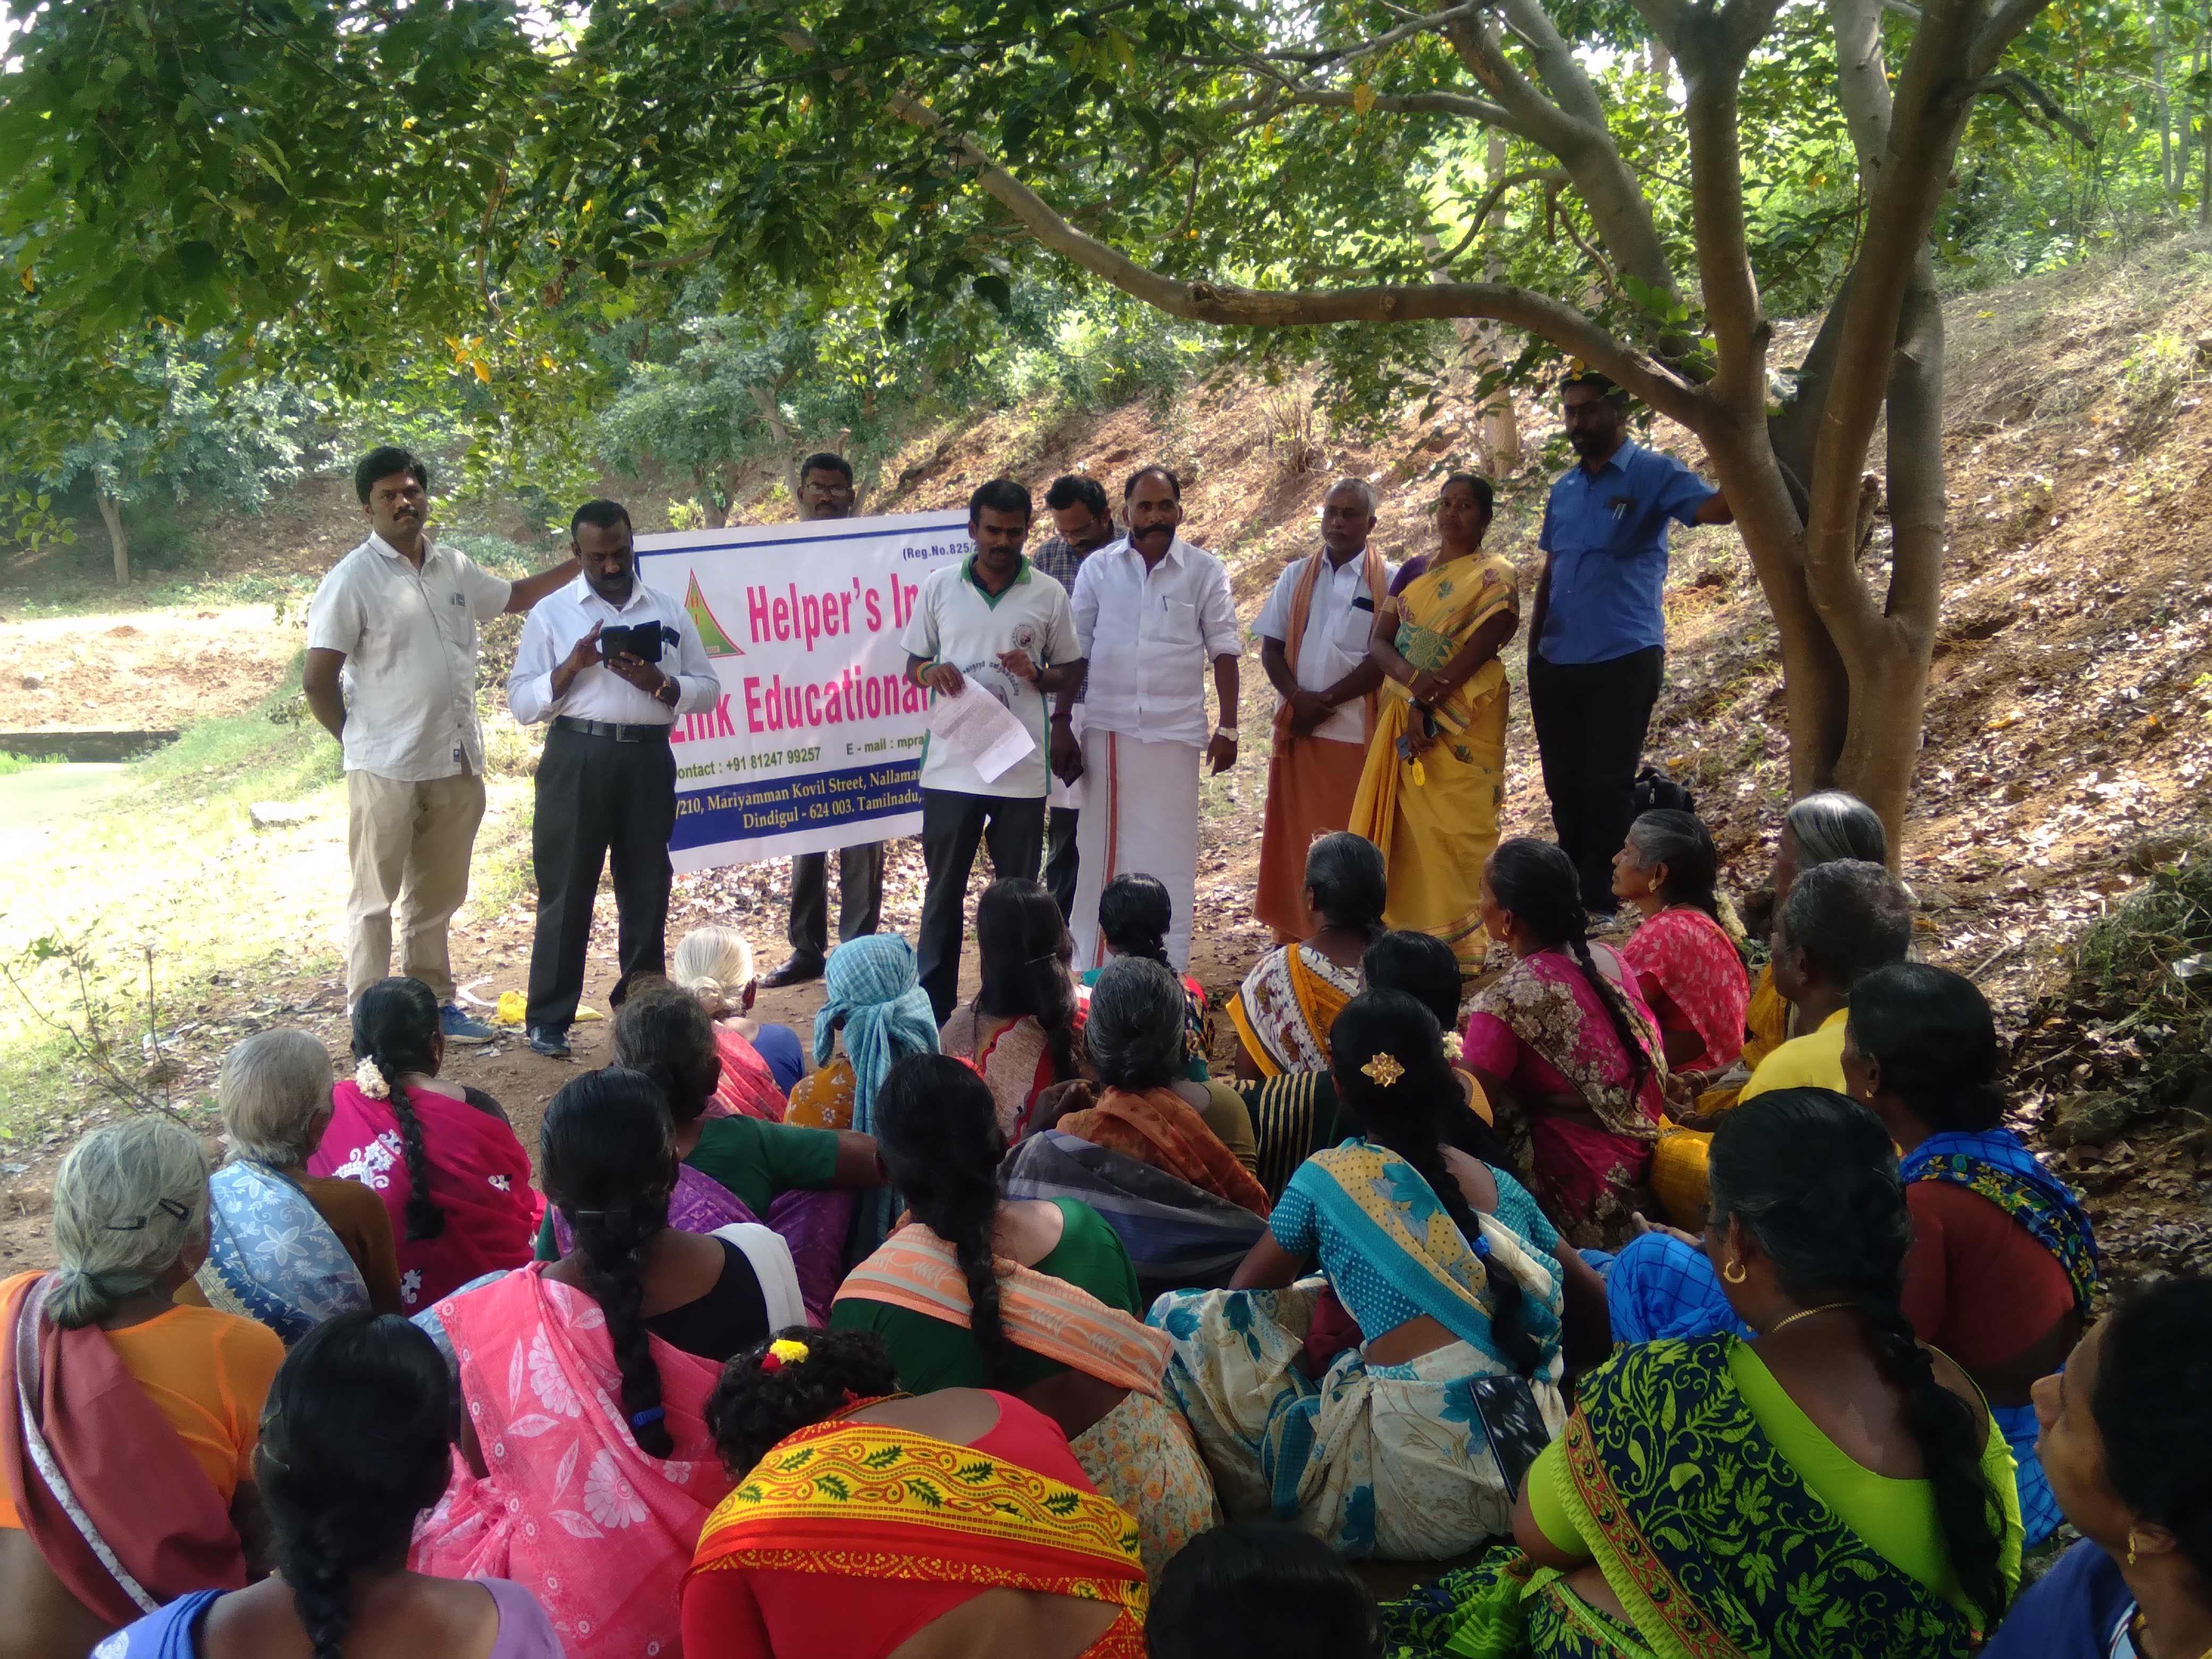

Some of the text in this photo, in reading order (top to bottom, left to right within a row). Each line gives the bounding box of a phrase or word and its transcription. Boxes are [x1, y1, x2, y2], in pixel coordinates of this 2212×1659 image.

[747, 576, 882, 652] Helper's
[676, 760, 716, 779] ontact
[726, 756, 747, 772] +91
[750, 751, 783, 769] 81247
[787, 746, 821, 764] 99257
[707, 787, 790, 811] Mariyamman
[792, 778, 826, 798] Kovil
[828, 775, 867, 793] Street,
[742, 806, 799, 829] Dindigul
[809, 802, 830, 819] 624
[832, 798, 855, 816] 003.
[856, 789, 922, 811] Tamilnadu,
